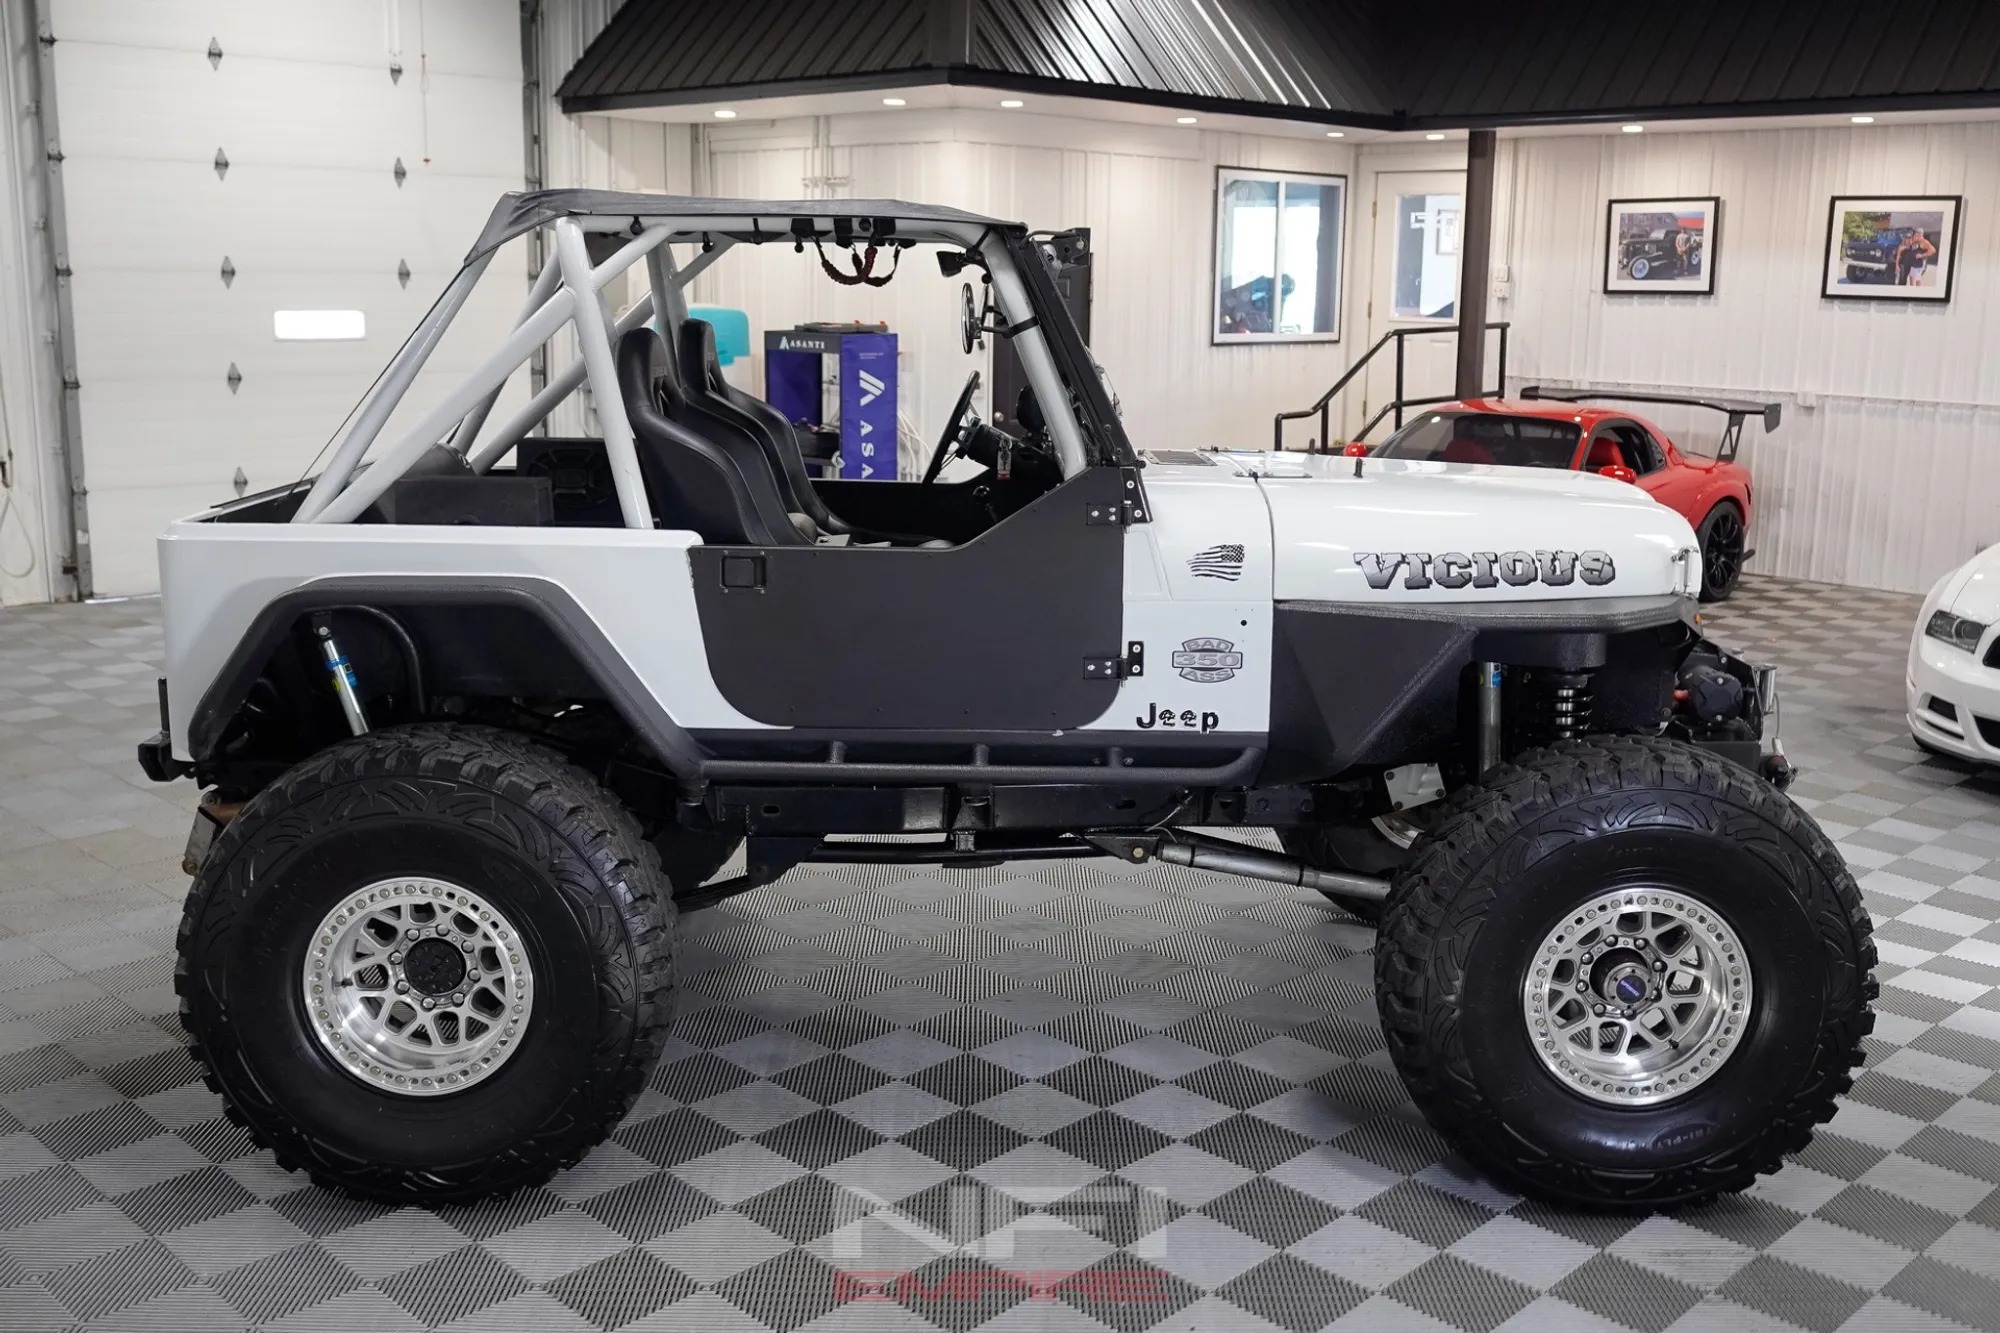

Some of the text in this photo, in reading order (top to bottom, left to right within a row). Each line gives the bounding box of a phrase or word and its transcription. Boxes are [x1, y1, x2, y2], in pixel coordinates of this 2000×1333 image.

[789, 339, 825, 350] ASANTI
[1353, 549, 1616, 590] VICIOUS
[1186, 640, 1230, 652] BAD
[1174, 653, 1240, 667] 350
[1181, 670, 1231, 681] ASS
[1136, 702, 1219, 733] Jeep
